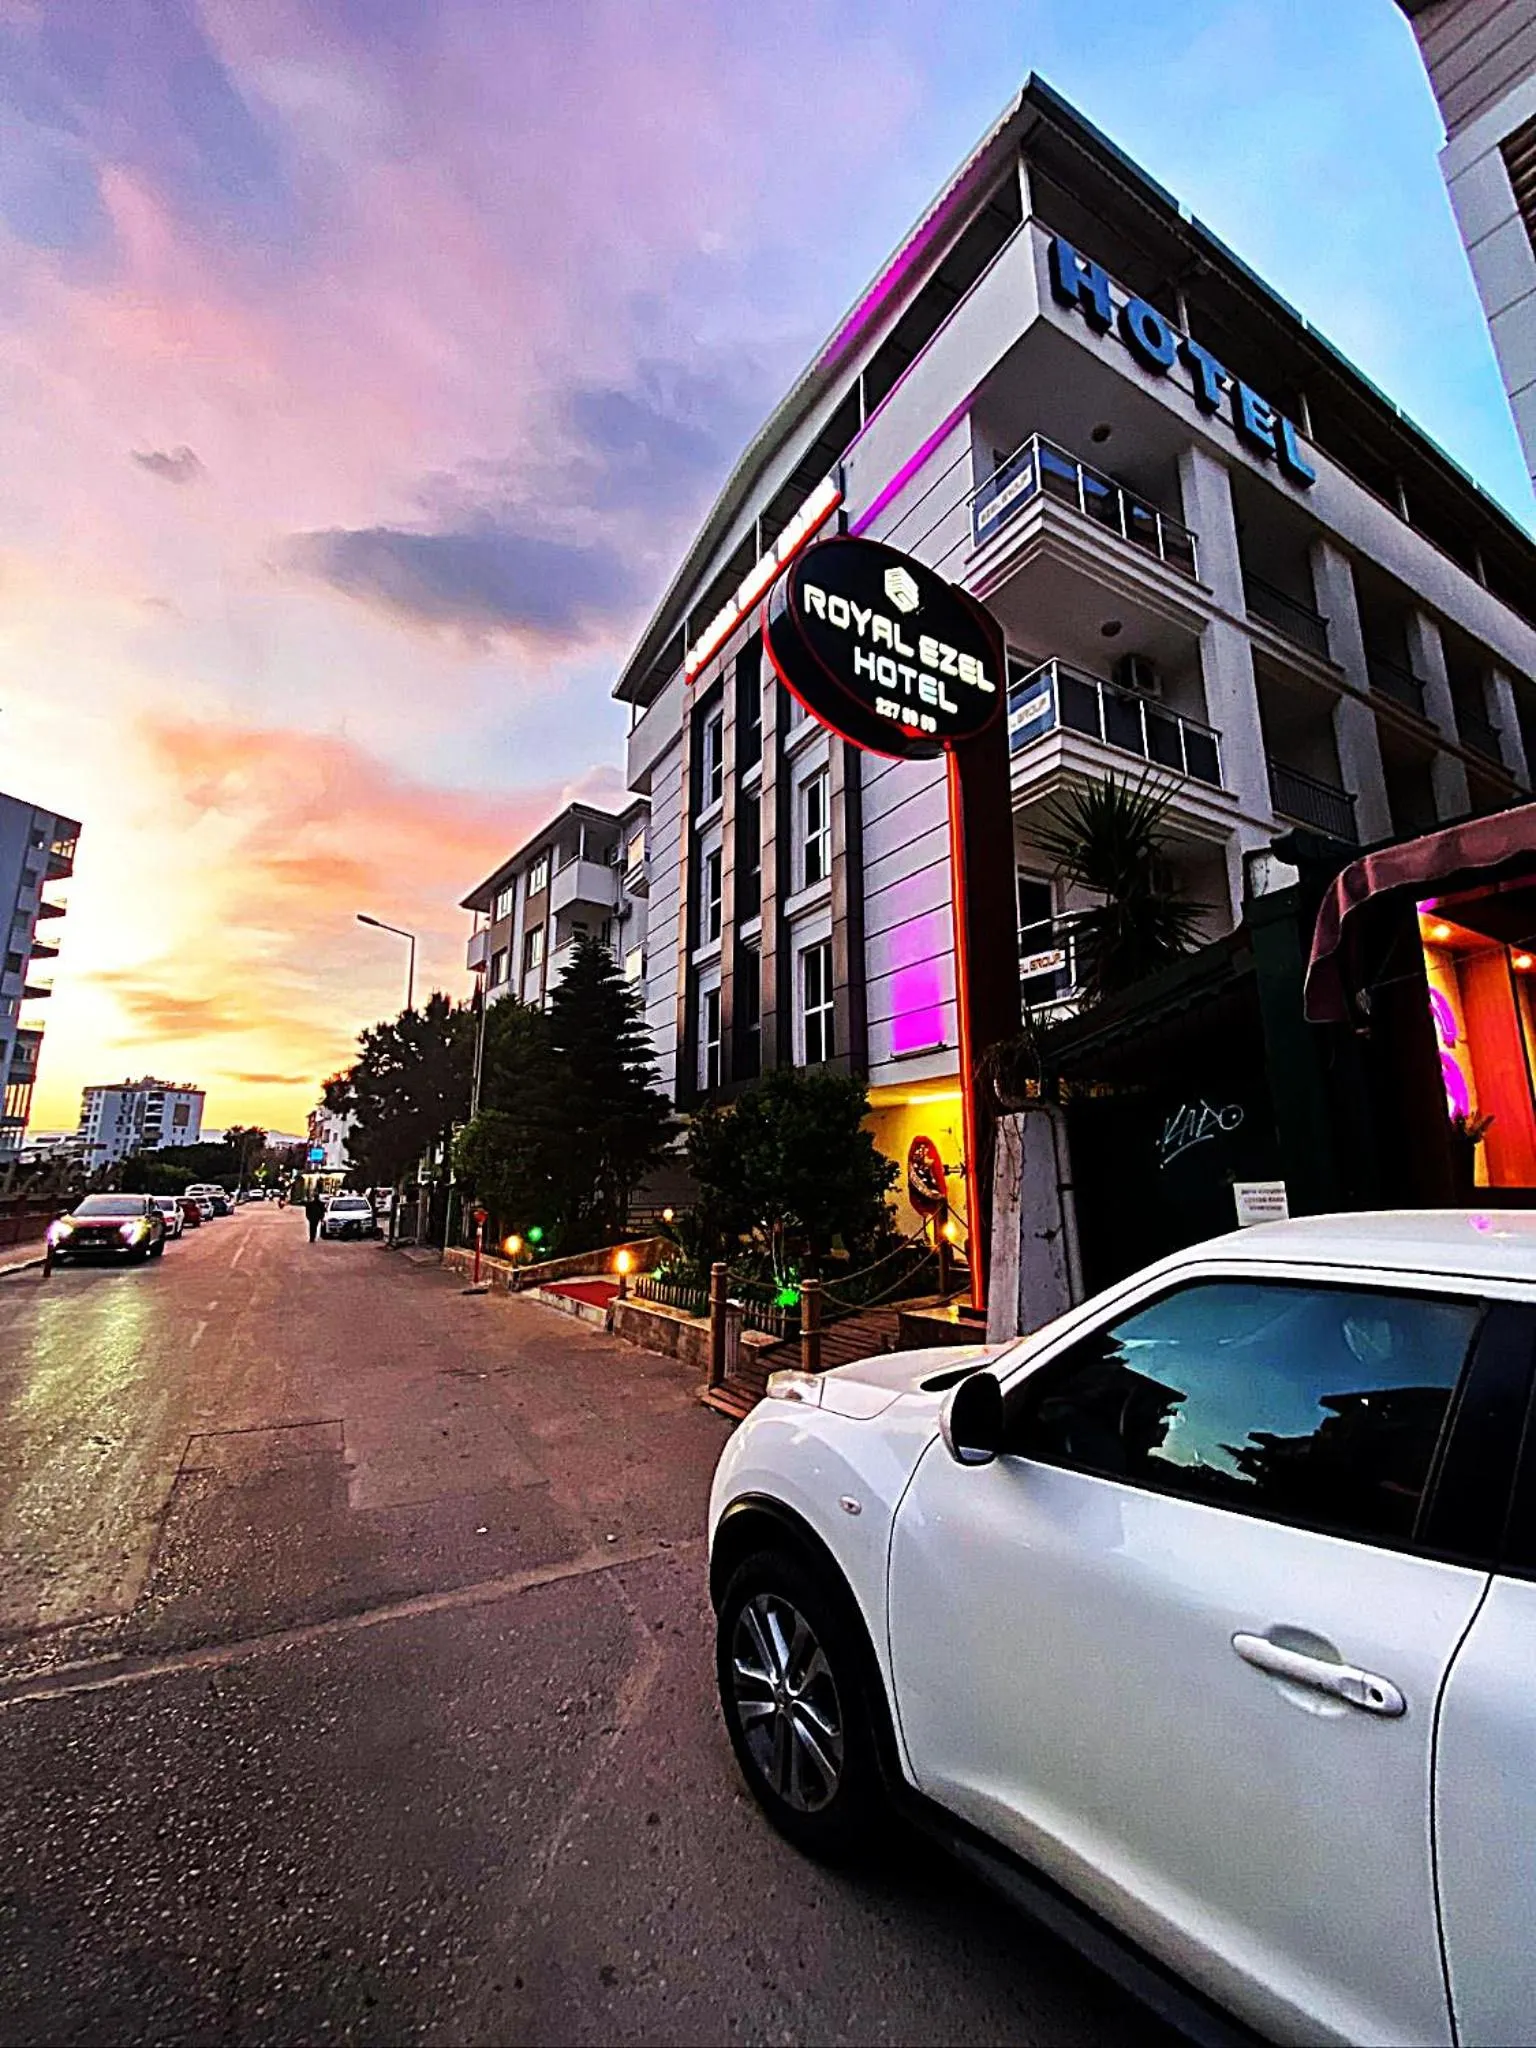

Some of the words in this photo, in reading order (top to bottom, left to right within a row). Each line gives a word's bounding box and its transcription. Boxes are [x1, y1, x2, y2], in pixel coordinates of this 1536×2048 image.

[1048, 235, 1316, 490] HOTEL
[804, 584, 915, 658] ROYAL
[919, 634, 996, 693] EZEL
[854, 646, 958, 714] HOTEL
